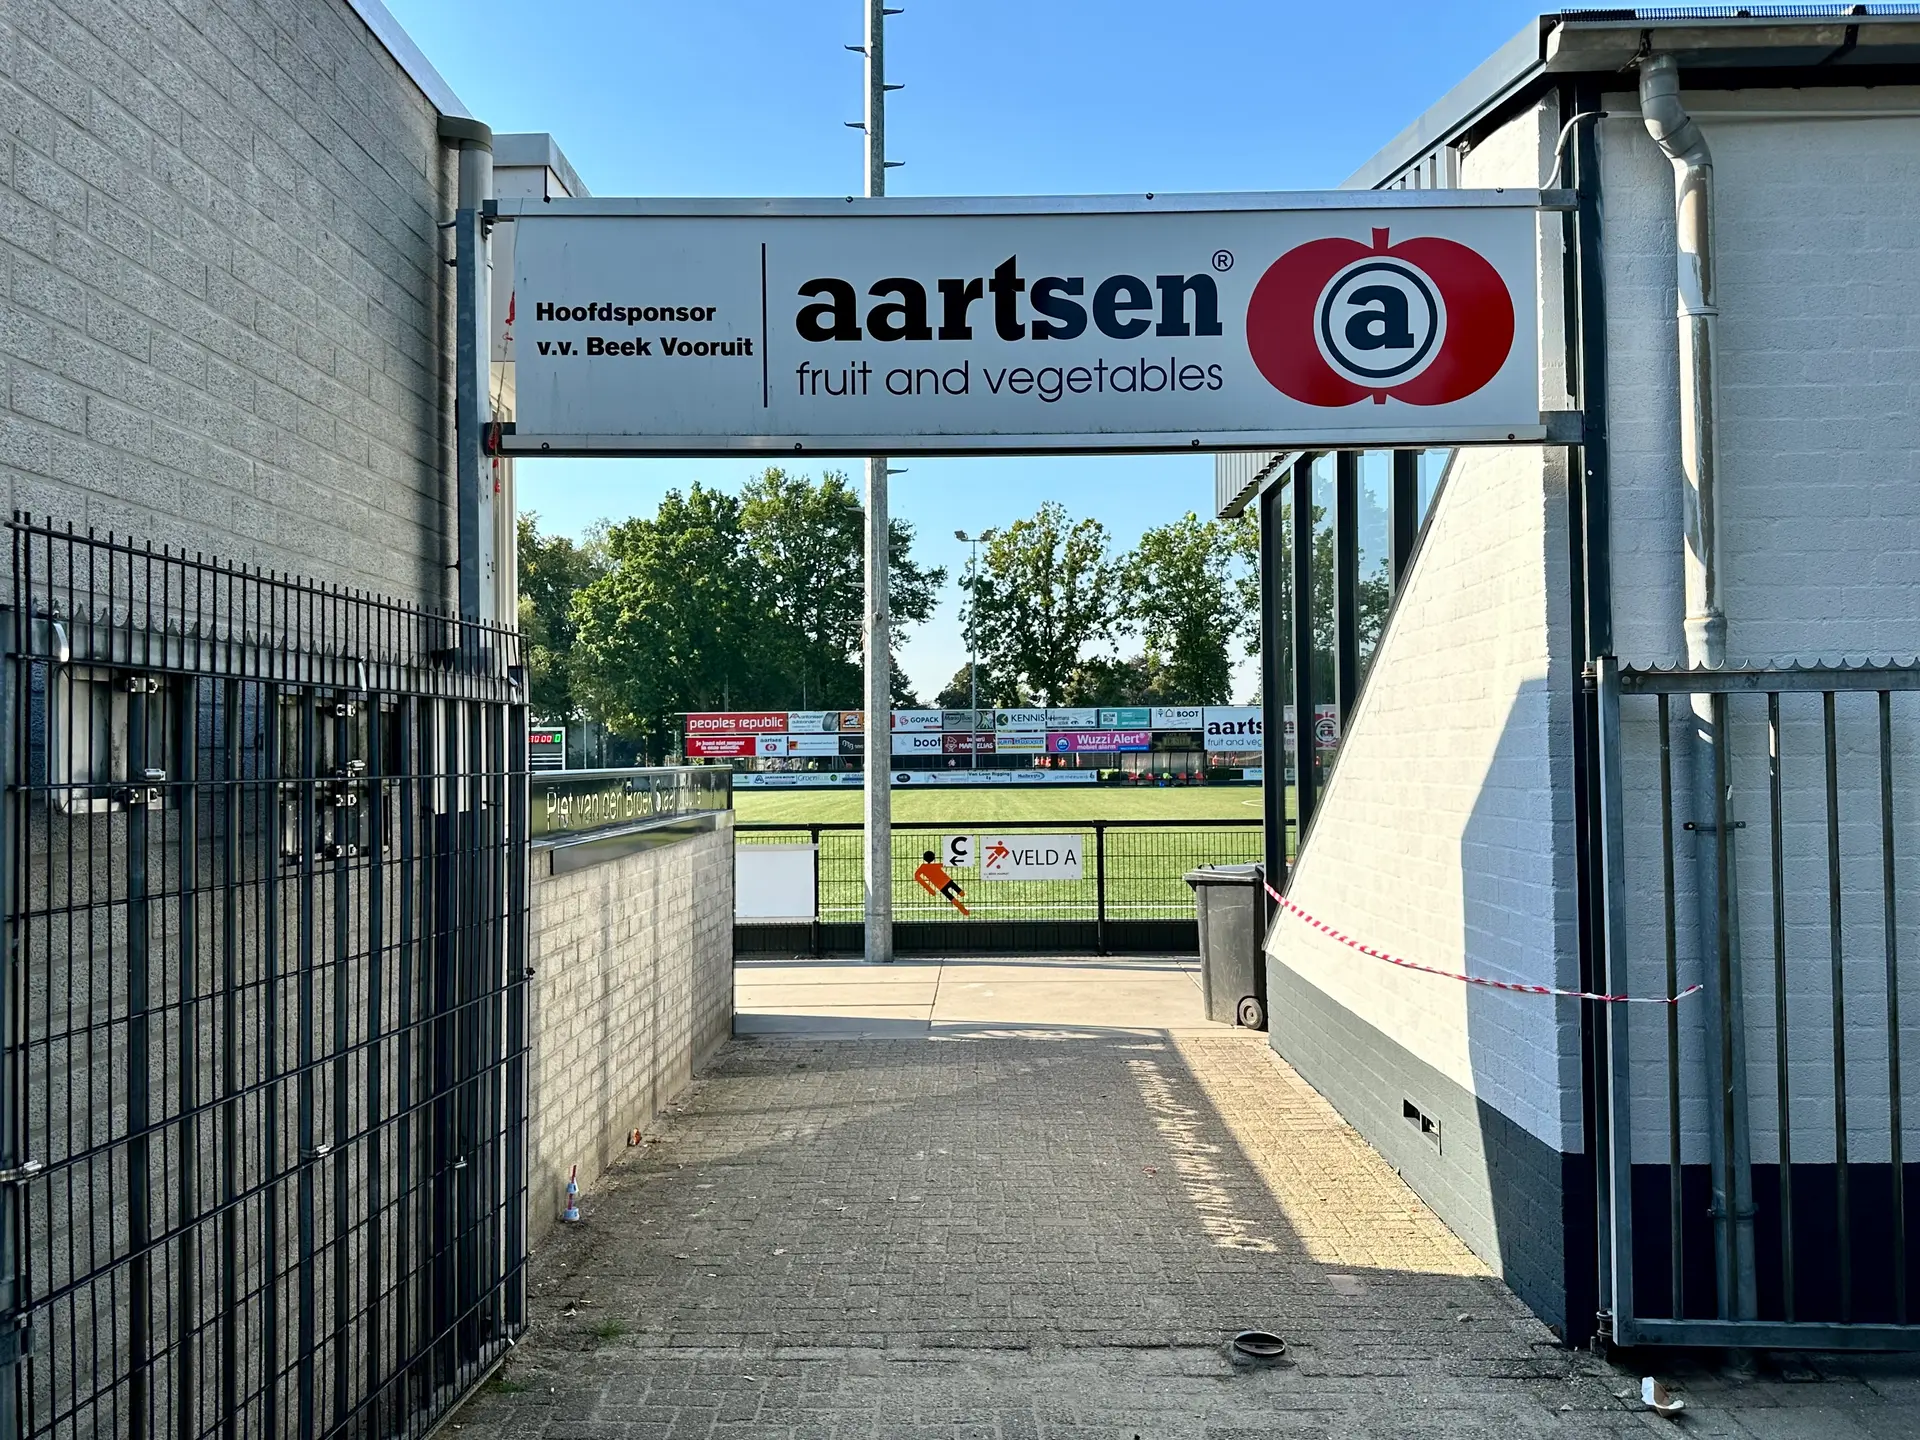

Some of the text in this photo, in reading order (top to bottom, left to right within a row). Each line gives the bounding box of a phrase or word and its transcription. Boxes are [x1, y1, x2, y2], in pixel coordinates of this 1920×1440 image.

[795, 253, 1223, 343] aartsen
[536, 302, 717, 326] Hoofdsponsor
[536, 336, 754, 357] v.v. Beek Vooruit
[796, 356, 1224, 404] fruit and vegetables
[1011, 713, 1045, 722] KENNIS
[1176, 710, 1200, 718] BOOT
[689, 717, 736, 731] peoples
[739, 716, 784, 730] republic
[1208, 717, 1263, 735] aarts
[913, 736, 941, 747] boot
[1077, 733, 1141, 744] Wuzzi Alert
[1207, 738, 1224, 746] fruit
[1224, 738, 1244, 746] and
[576, 793, 600, 825] van
[950, 836, 968, 856] C
[1012, 849, 1077, 866] VELD A
